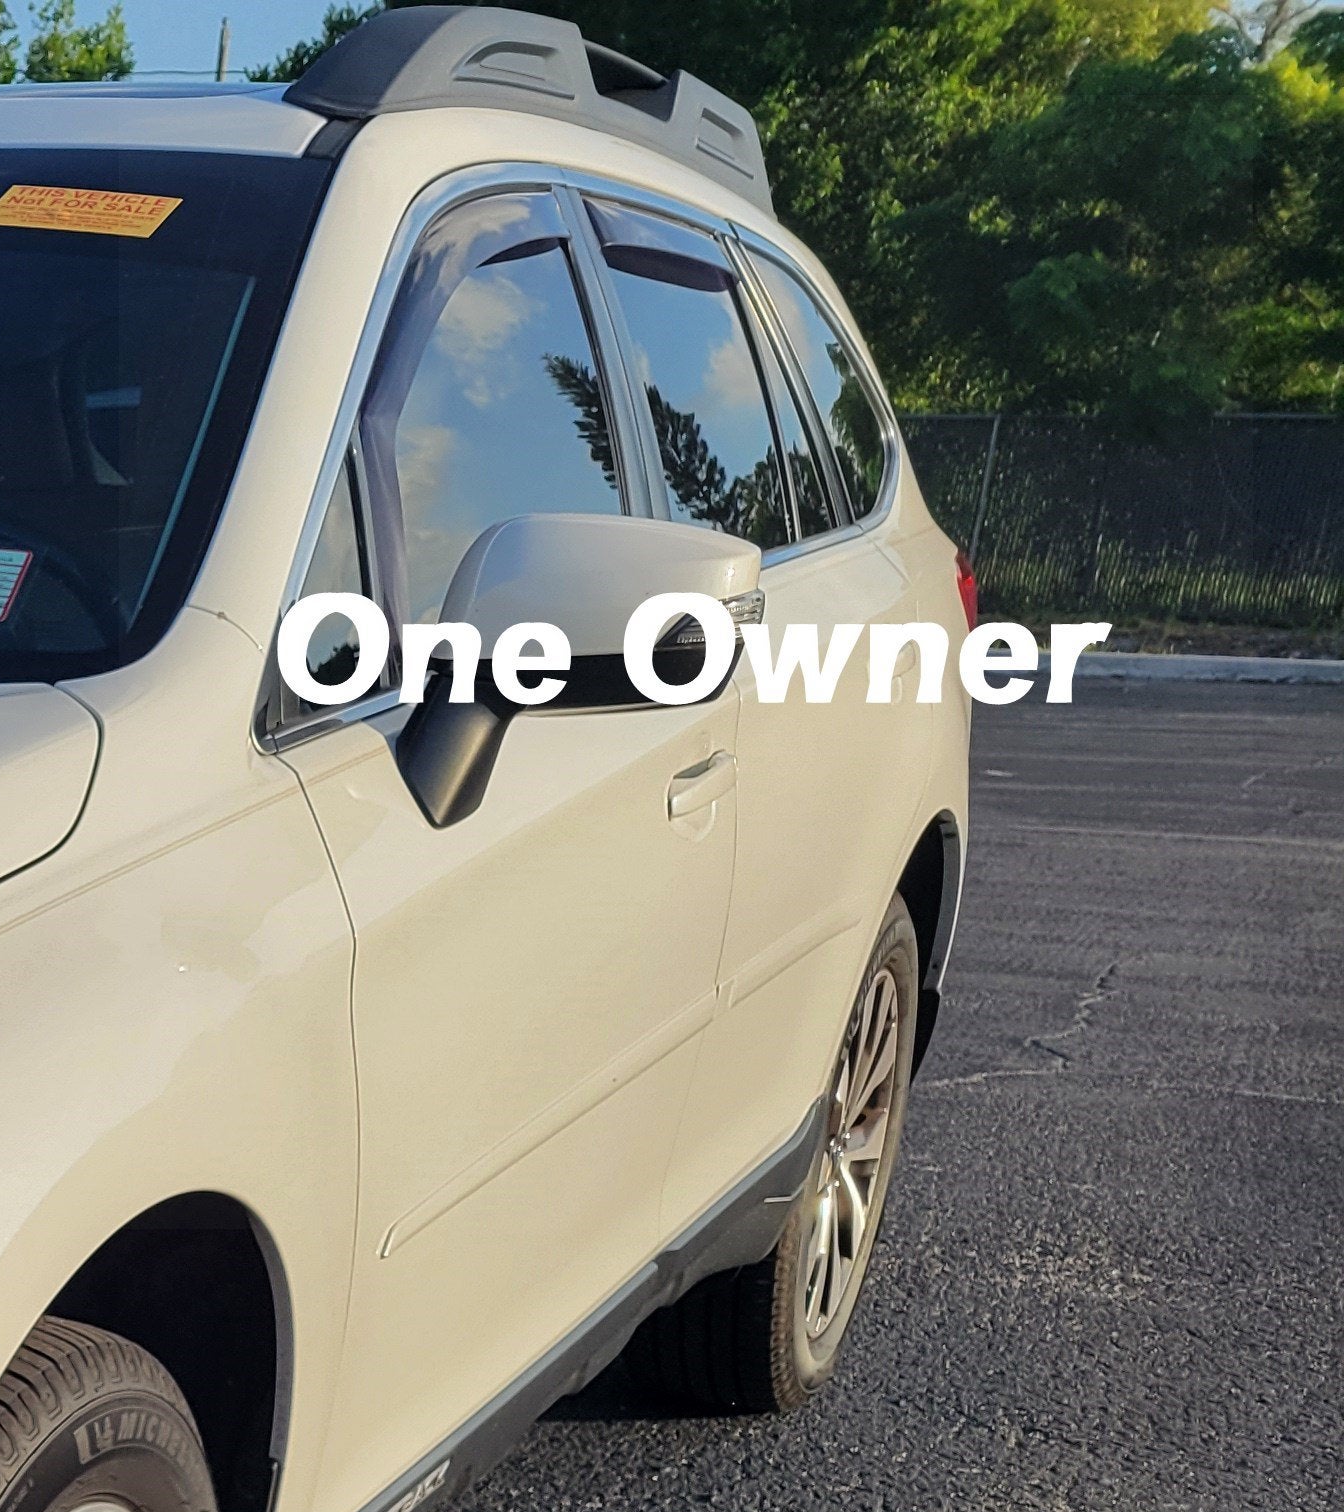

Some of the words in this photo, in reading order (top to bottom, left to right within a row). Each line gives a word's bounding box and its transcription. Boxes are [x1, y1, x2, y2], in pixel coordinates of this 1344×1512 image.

[17, 186, 65, 198] THIS
[71, 189, 169, 207] VEHICLE
[49, 198, 98, 211] FOR
[102, 201, 166, 216] SALE
